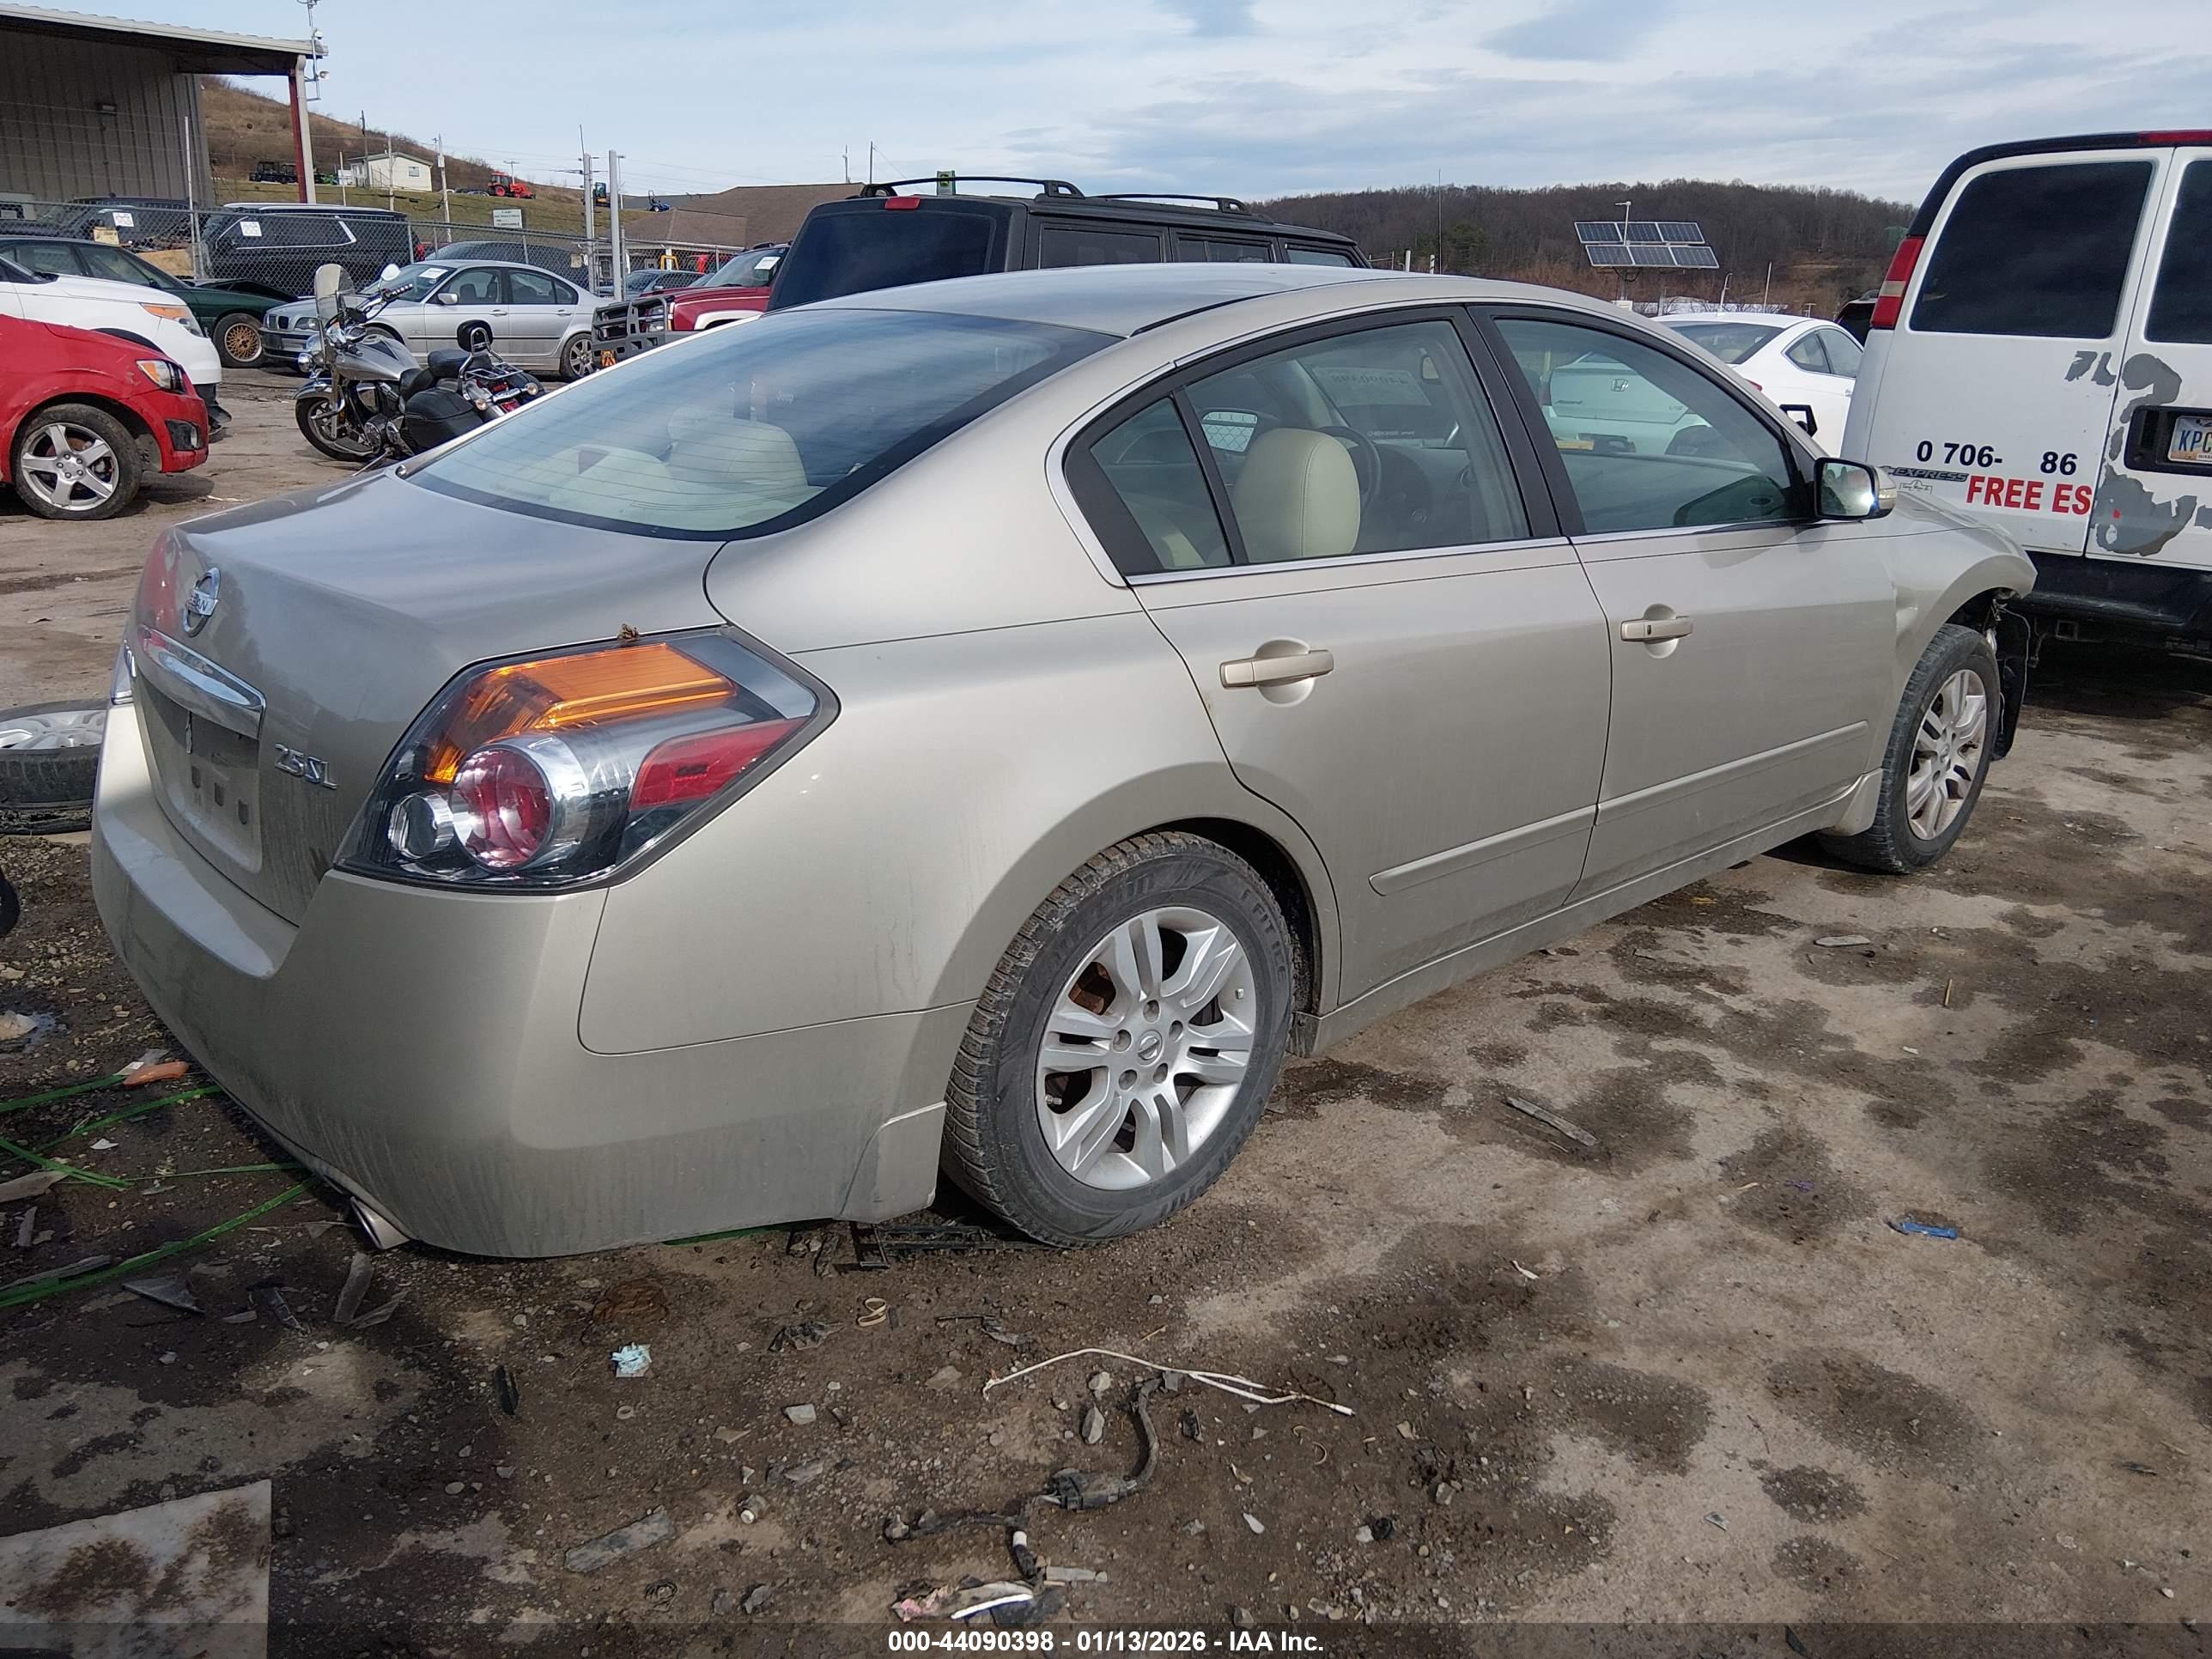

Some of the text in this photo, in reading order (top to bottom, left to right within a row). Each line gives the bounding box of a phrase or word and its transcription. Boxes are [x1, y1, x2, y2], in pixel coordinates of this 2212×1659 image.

[1894, 467, 1969, 482] EXPRESS
[1917, 441, 2078, 476] 0 706- 86
[1966, 476, 2045, 510] FREE
[2052, 484, 2094, 516] ES
